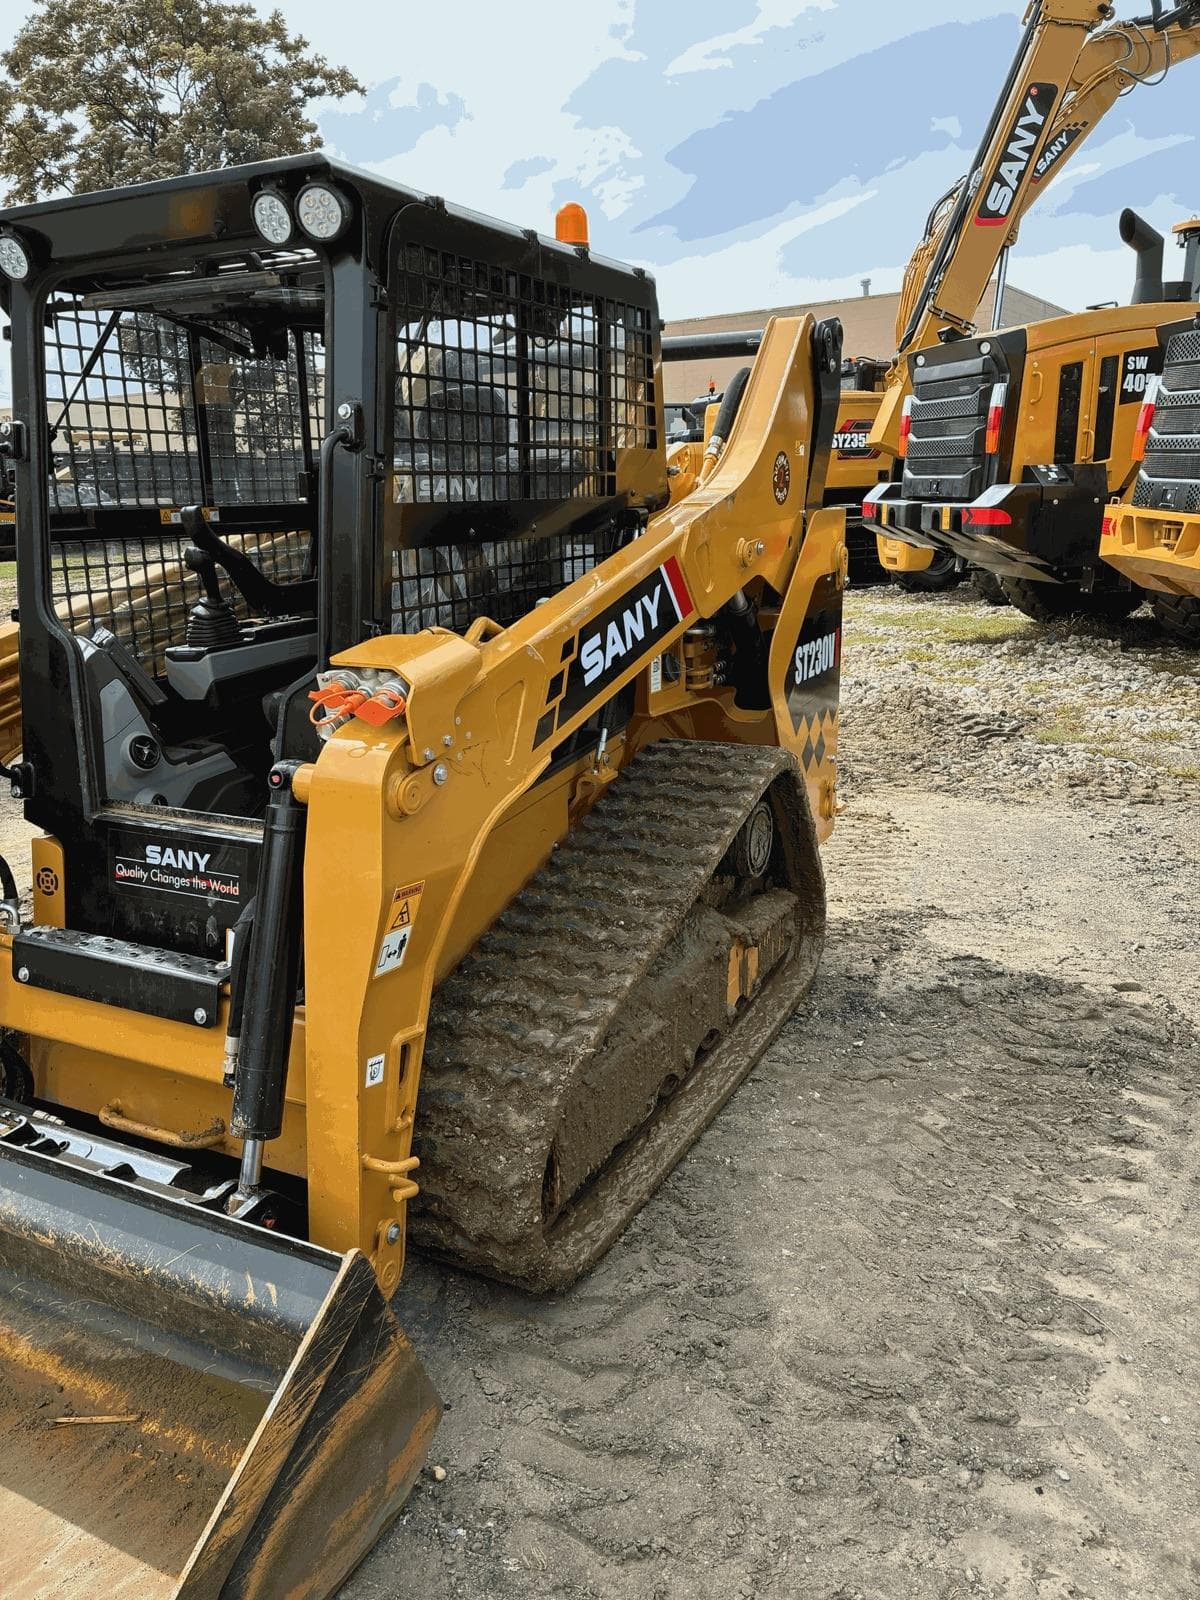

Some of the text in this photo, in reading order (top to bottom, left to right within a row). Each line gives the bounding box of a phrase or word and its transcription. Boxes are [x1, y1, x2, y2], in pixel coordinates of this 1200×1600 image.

[987, 96, 1045, 215] SANY
[1037, 131, 1069, 174] SANY
[1127, 356, 1149, 370] SW
[418, 478, 479, 496] SANY
[580, 583, 662, 687] SANY
[795, 632, 836, 685] ST230V
[145, 844, 211, 873] SANY
[115, 863, 240, 896] Quality Changes the World
